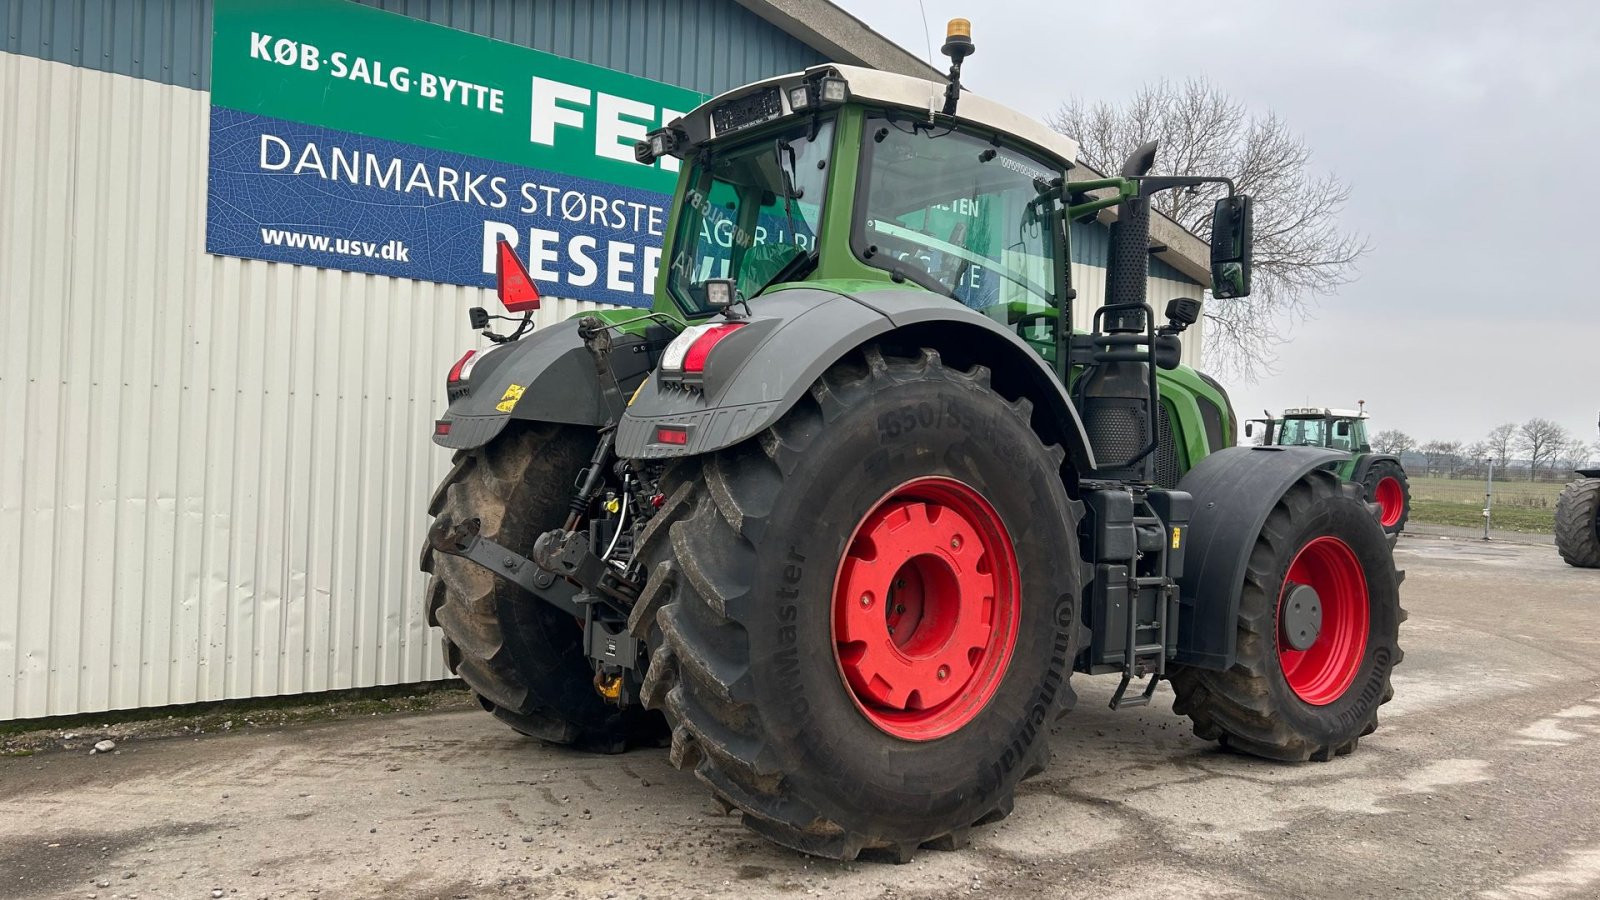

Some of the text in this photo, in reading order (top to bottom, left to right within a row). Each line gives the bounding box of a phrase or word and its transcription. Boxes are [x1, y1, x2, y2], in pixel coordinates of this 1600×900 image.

[260, 134, 507, 209] DANMARKS
[521, 182, 664, 237] STØRSTE
[261, 228, 409, 262] www.usv.dk
[992, 592, 1075, 789] Continental
[1337, 646, 1392, 729] Continental
